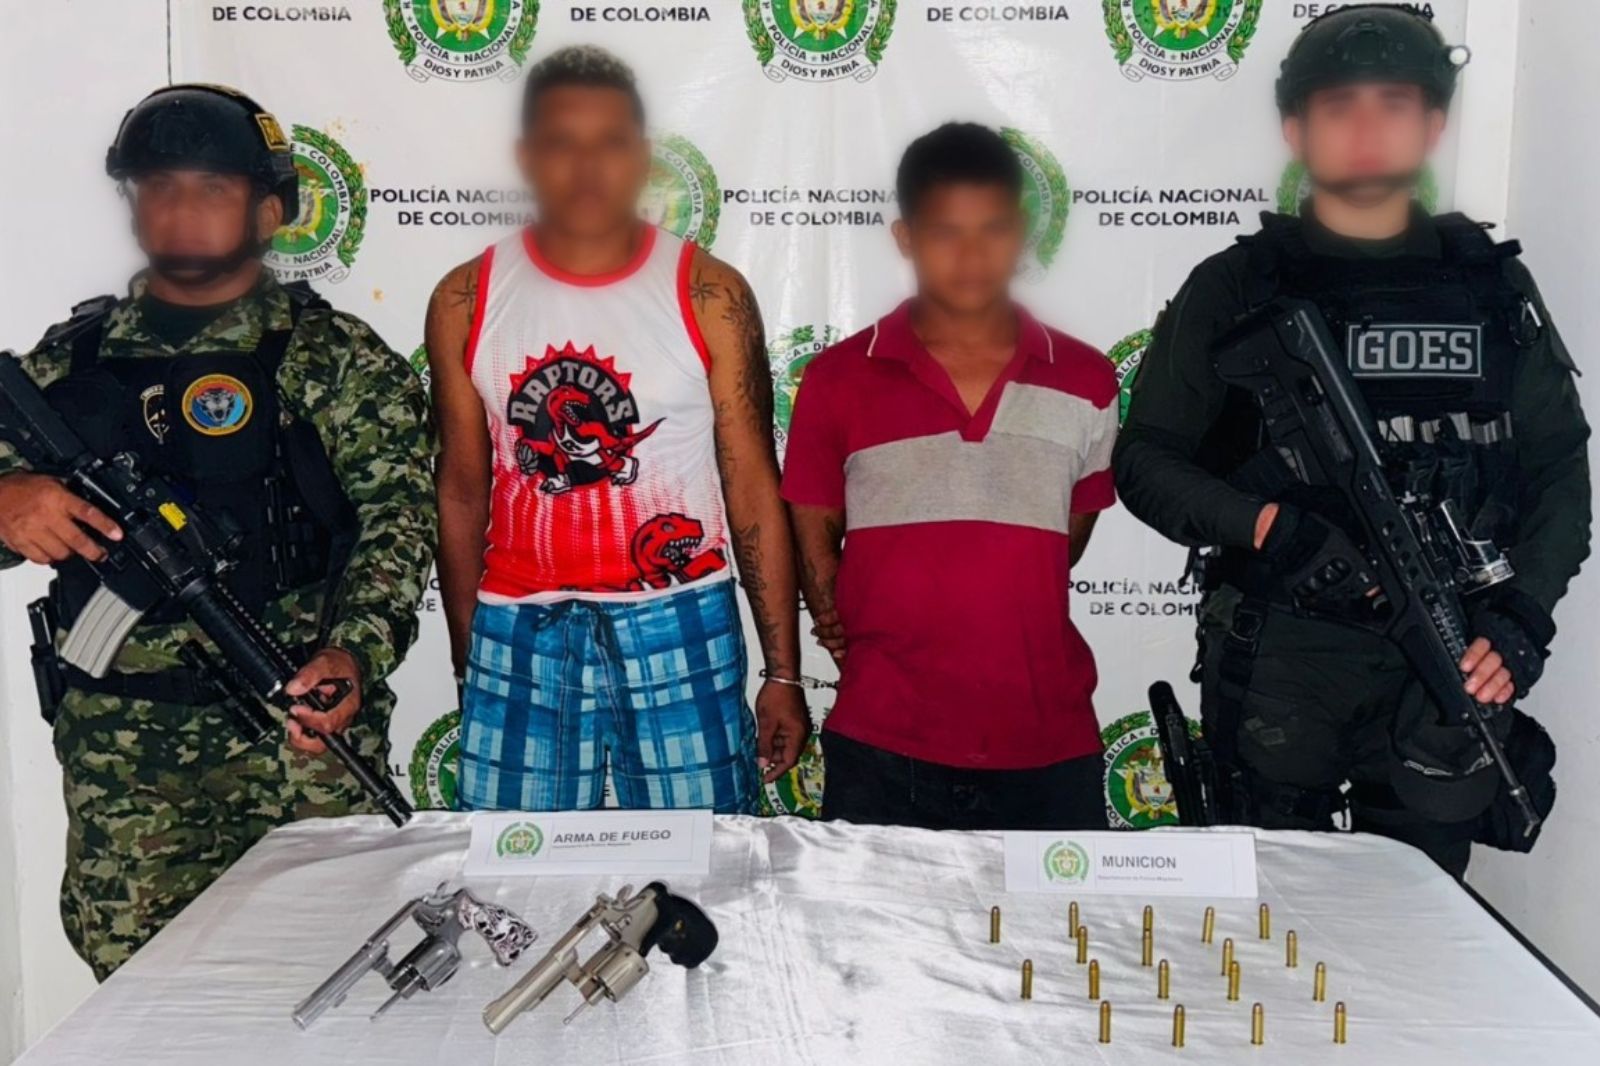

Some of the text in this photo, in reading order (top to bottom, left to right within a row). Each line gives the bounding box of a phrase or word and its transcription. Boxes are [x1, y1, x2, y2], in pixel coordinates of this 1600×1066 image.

[212, 6, 352, 21] DE COLOMBIA
[570, 7, 711, 21] DE COLOMBIA
[927, 6, 1070, 21] DE COLOMBIA
[1293, 4, 1319, 18] DE
[464, 25, 516, 62] NACIONAL
[821, 24, 873, 62] NACIONAL
[1180, 22, 1237, 61] NACIONAL
[424, 59, 504, 78] DIOS Y PATRIA
[781, 59, 860, 78] DIOS Y PATRIA
[1139, 58, 1221, 77] DIOS Y PATRIA
[309, 150, 348, 213] COLOMBIA
[664, 151, 702, 214] COLOMBIA
[370, 186, 534, 203] POLICÍA NACION
[723, 186, 897, 203] POLICÍA NACIONA
[1073, 186, 1269, 204] POLICÍA NACIONAL
[398, 211, 536, 226] DE COLOMBIA
[750, 212, 885, 226] DE COLOMBIA
[1099, 211, 1240, 226] DE COLOMBIA
[293, 229, 343, 264] NACIONAL
[294, 261, 333, 279] PATRIA
[1358, 331, 1473, 370] GOES
[510, 360, 634, 424] RAPTORS
[1149, 581, 1200, 594] NACI
[1090, 602, 1200, 616] DE COLOM
[553, 829, 672, 844] ARMA DE FUEGO
[1102, 855, 1176, 869] MUNICION
